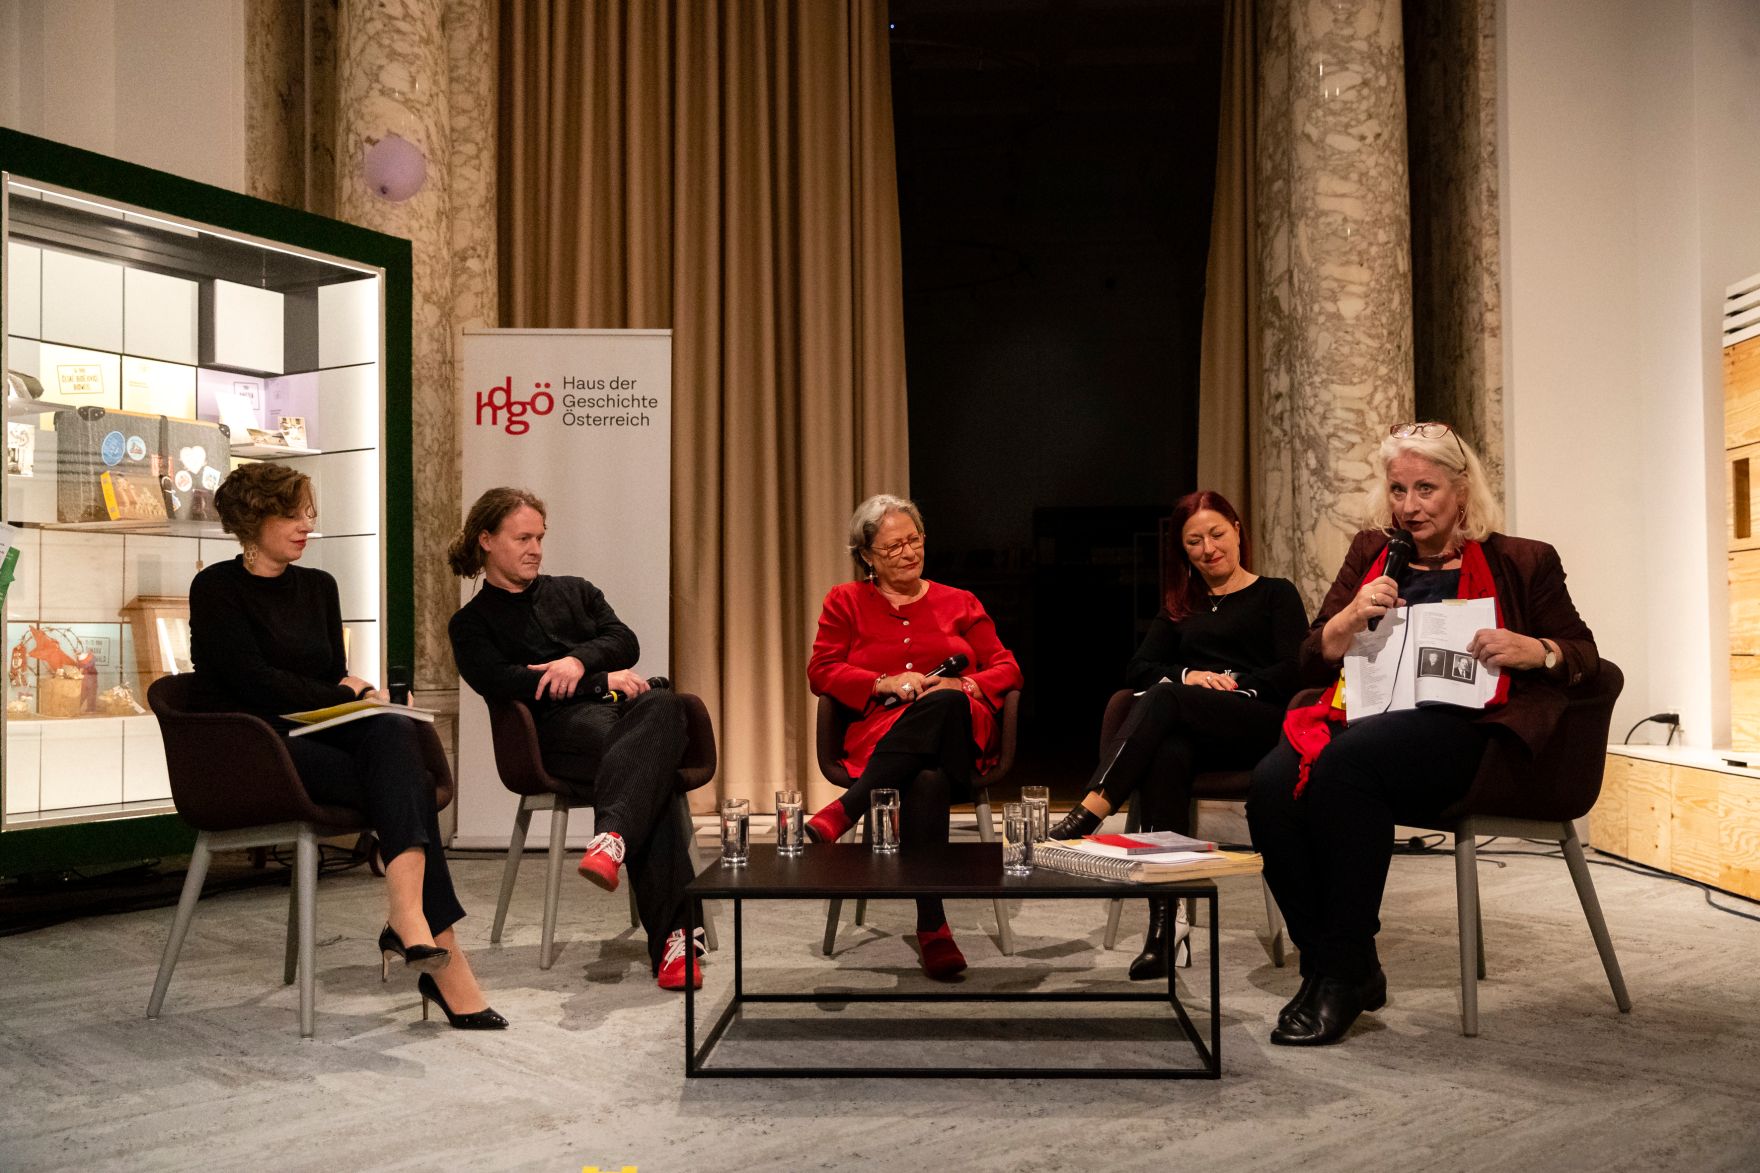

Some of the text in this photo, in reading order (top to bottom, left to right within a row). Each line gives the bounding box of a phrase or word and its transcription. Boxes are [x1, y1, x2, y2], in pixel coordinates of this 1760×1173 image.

[563, 376, 637, 390] Haus der
[475, 376, 554, 435] hdgö
[562, 394, 658, 408] Geschichte
[562, 409, 650, 426] Österreich
